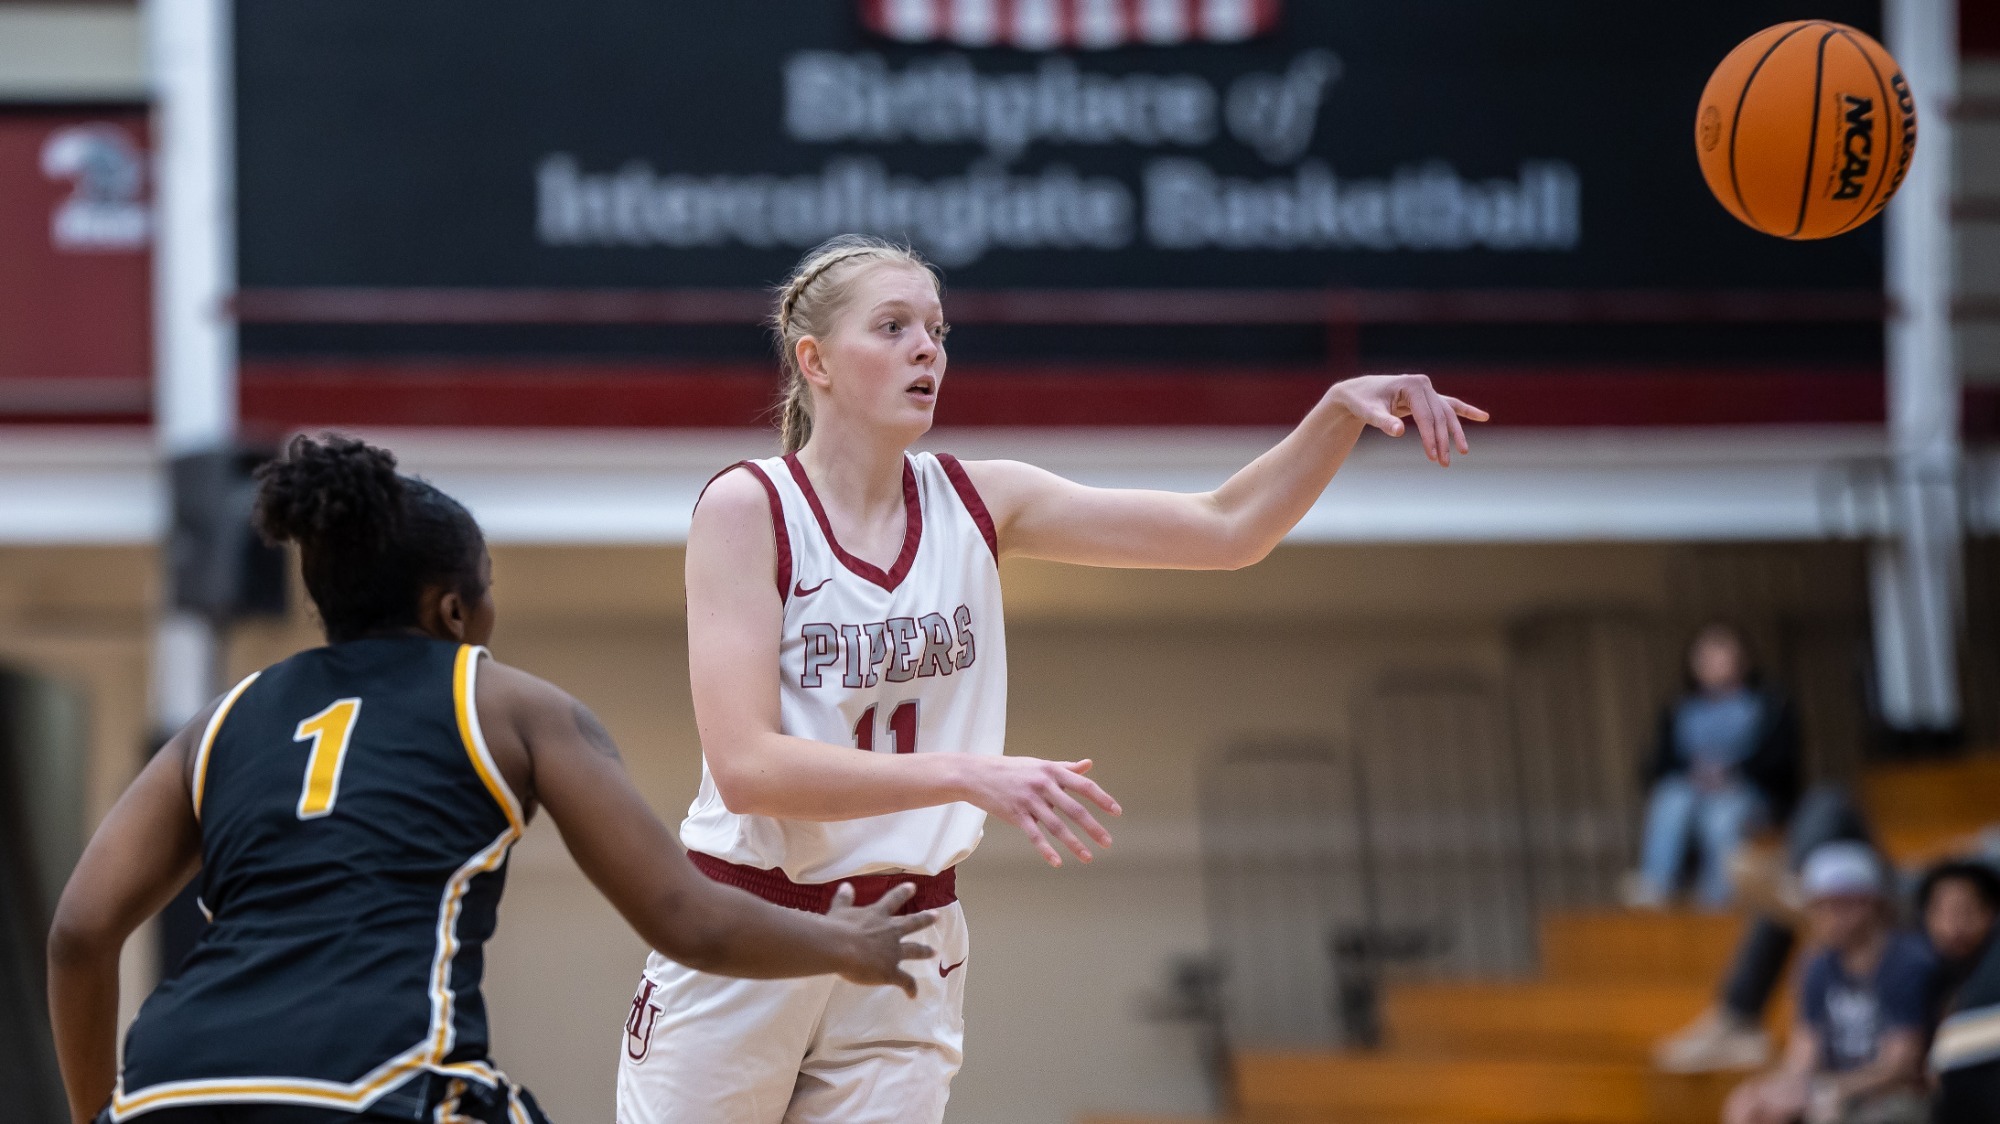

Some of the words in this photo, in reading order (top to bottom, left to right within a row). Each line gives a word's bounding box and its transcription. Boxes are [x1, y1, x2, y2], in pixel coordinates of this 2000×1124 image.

[787, 52, 1216, 156] Birthplace
[1225, 49, 1340, 162] of
[1831, 95, 1873, 200] NCAA
[538, 154, 1132, 264] Intercollegiate
[1143, 159, 1580, 249] Basketball
[801, 603, 976, 688] PIPERS
[293, 696, 362, 821] 1
